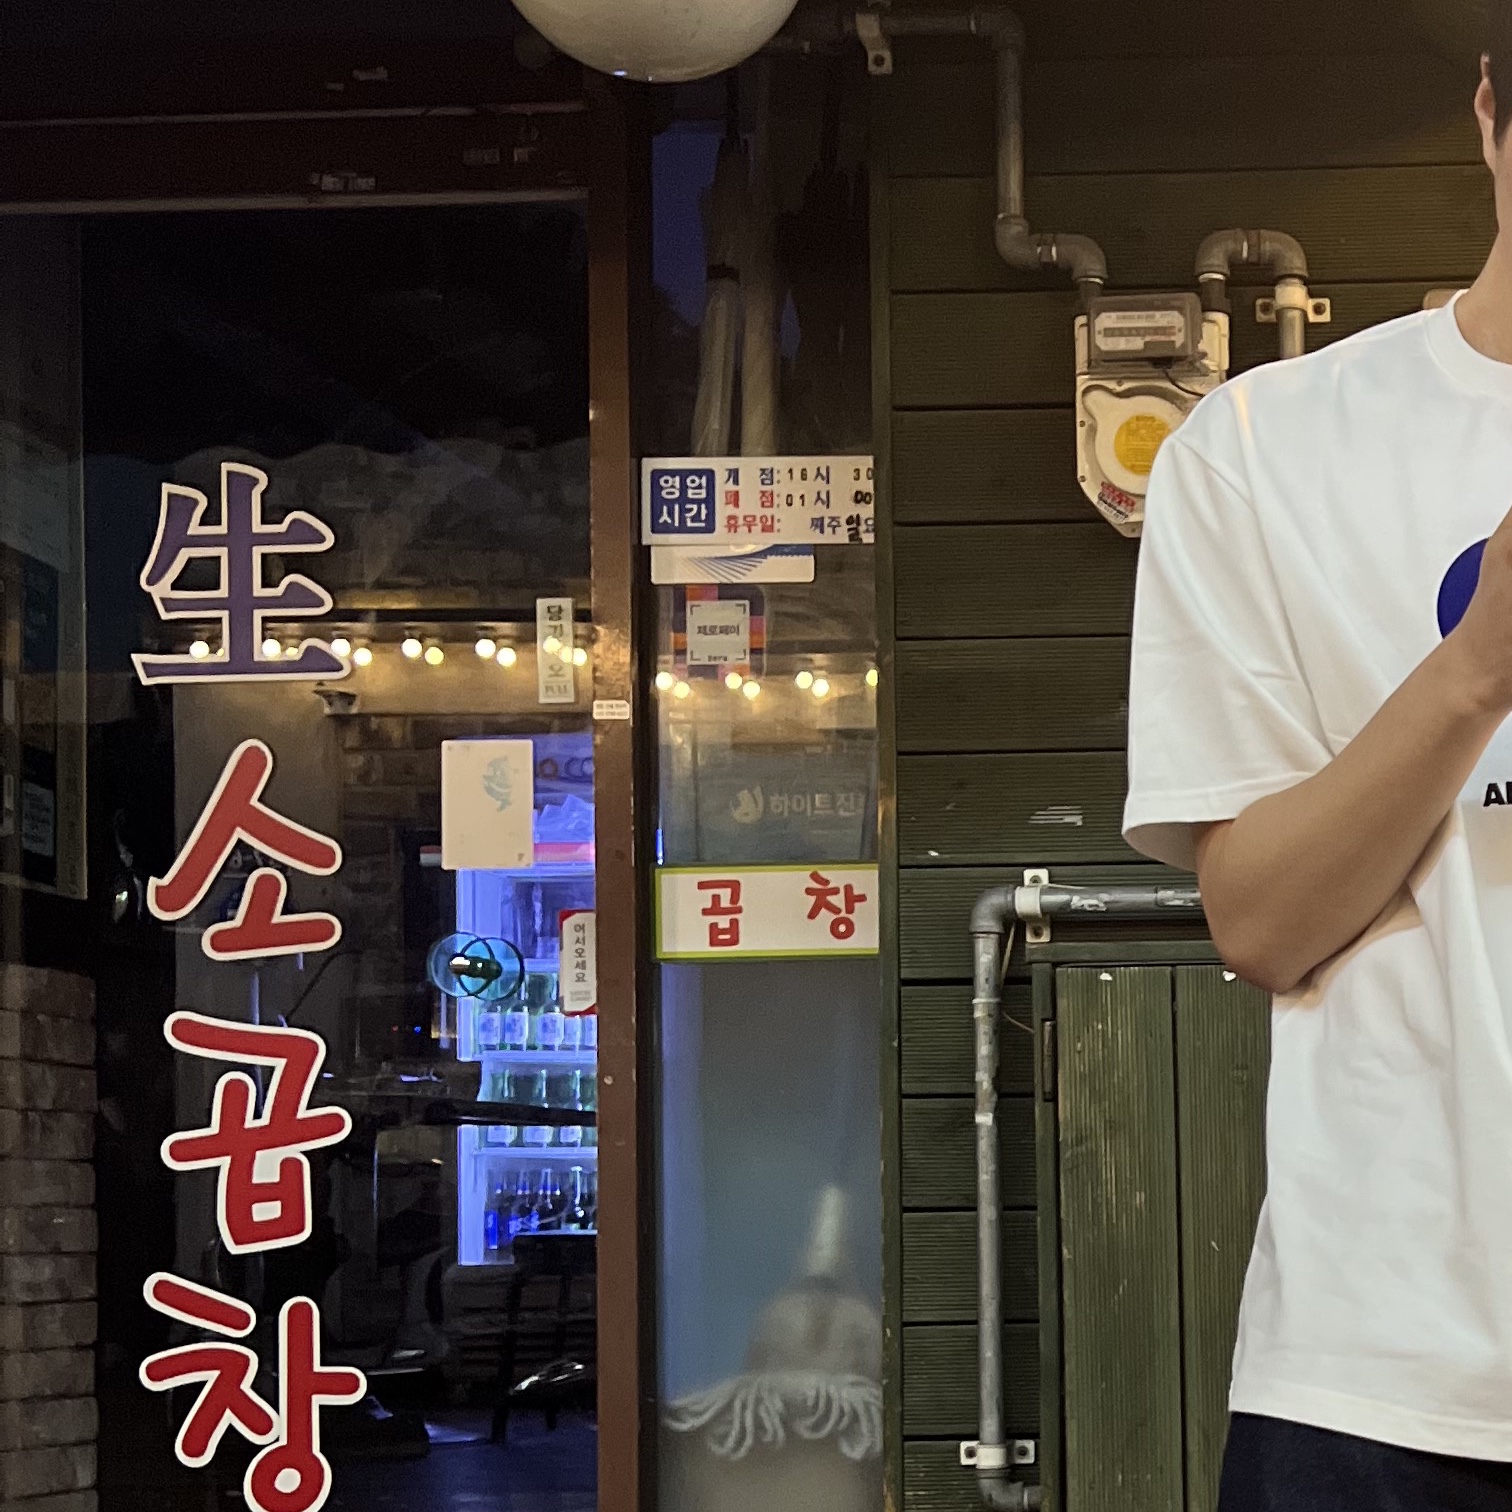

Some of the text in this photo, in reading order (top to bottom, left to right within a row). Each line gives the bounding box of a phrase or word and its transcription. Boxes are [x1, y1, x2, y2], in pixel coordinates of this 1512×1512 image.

[659, 475, 707, 499] 영업
[658, 504, 707, 527] 시간
[573, 922, 588, 983] 어서오세요
